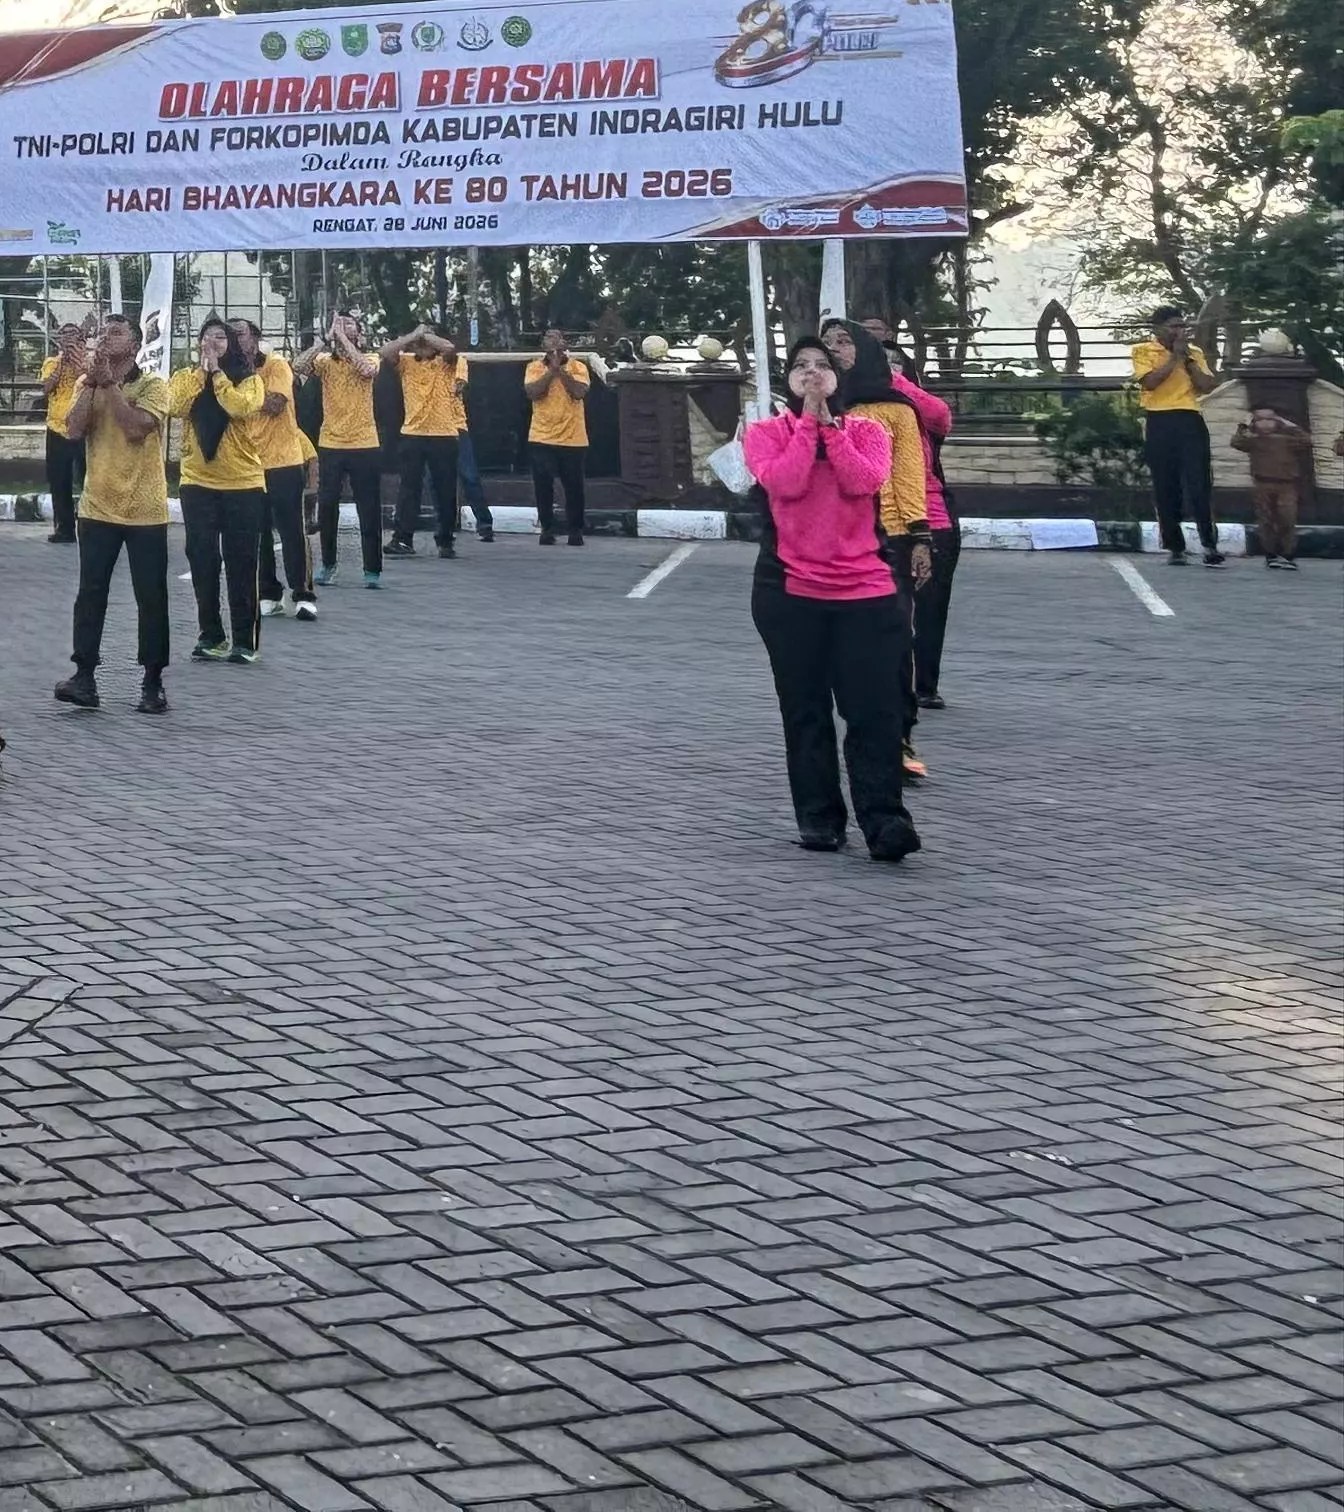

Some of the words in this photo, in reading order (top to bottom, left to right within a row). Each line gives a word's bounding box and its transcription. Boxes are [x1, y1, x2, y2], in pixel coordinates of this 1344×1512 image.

[159, 72, 398, 119] OLAHRAGA
[416, 58, 658, 108] BERSAMA
[14, 131, 135, 158] TNI-POLRI
[146, 128, 200, 153] DAN
[210, 121, 391, 150] FORKOPIMDA
[402, 111, 578, 144] KABUPATEN
[589, 103, 745, 136] INDRAGIRI
[758, 98, 844, 129] HULU
[300, 151, 389, 172] Dalam
[397, 147, 503, 172] Rangka
[106, 187, 171, 212] HARI
[182, 179, 402, 211] BHAYANGKARA
[413, 177, 454, 205] KE
[465, 175, 508, 203] 80
[520, 171, 628, 202] TAHUN
[641, 168, 733, 198] 2026
[411, 216, 448, 231] JUNI
[454, 214, 499, 230] 2026
